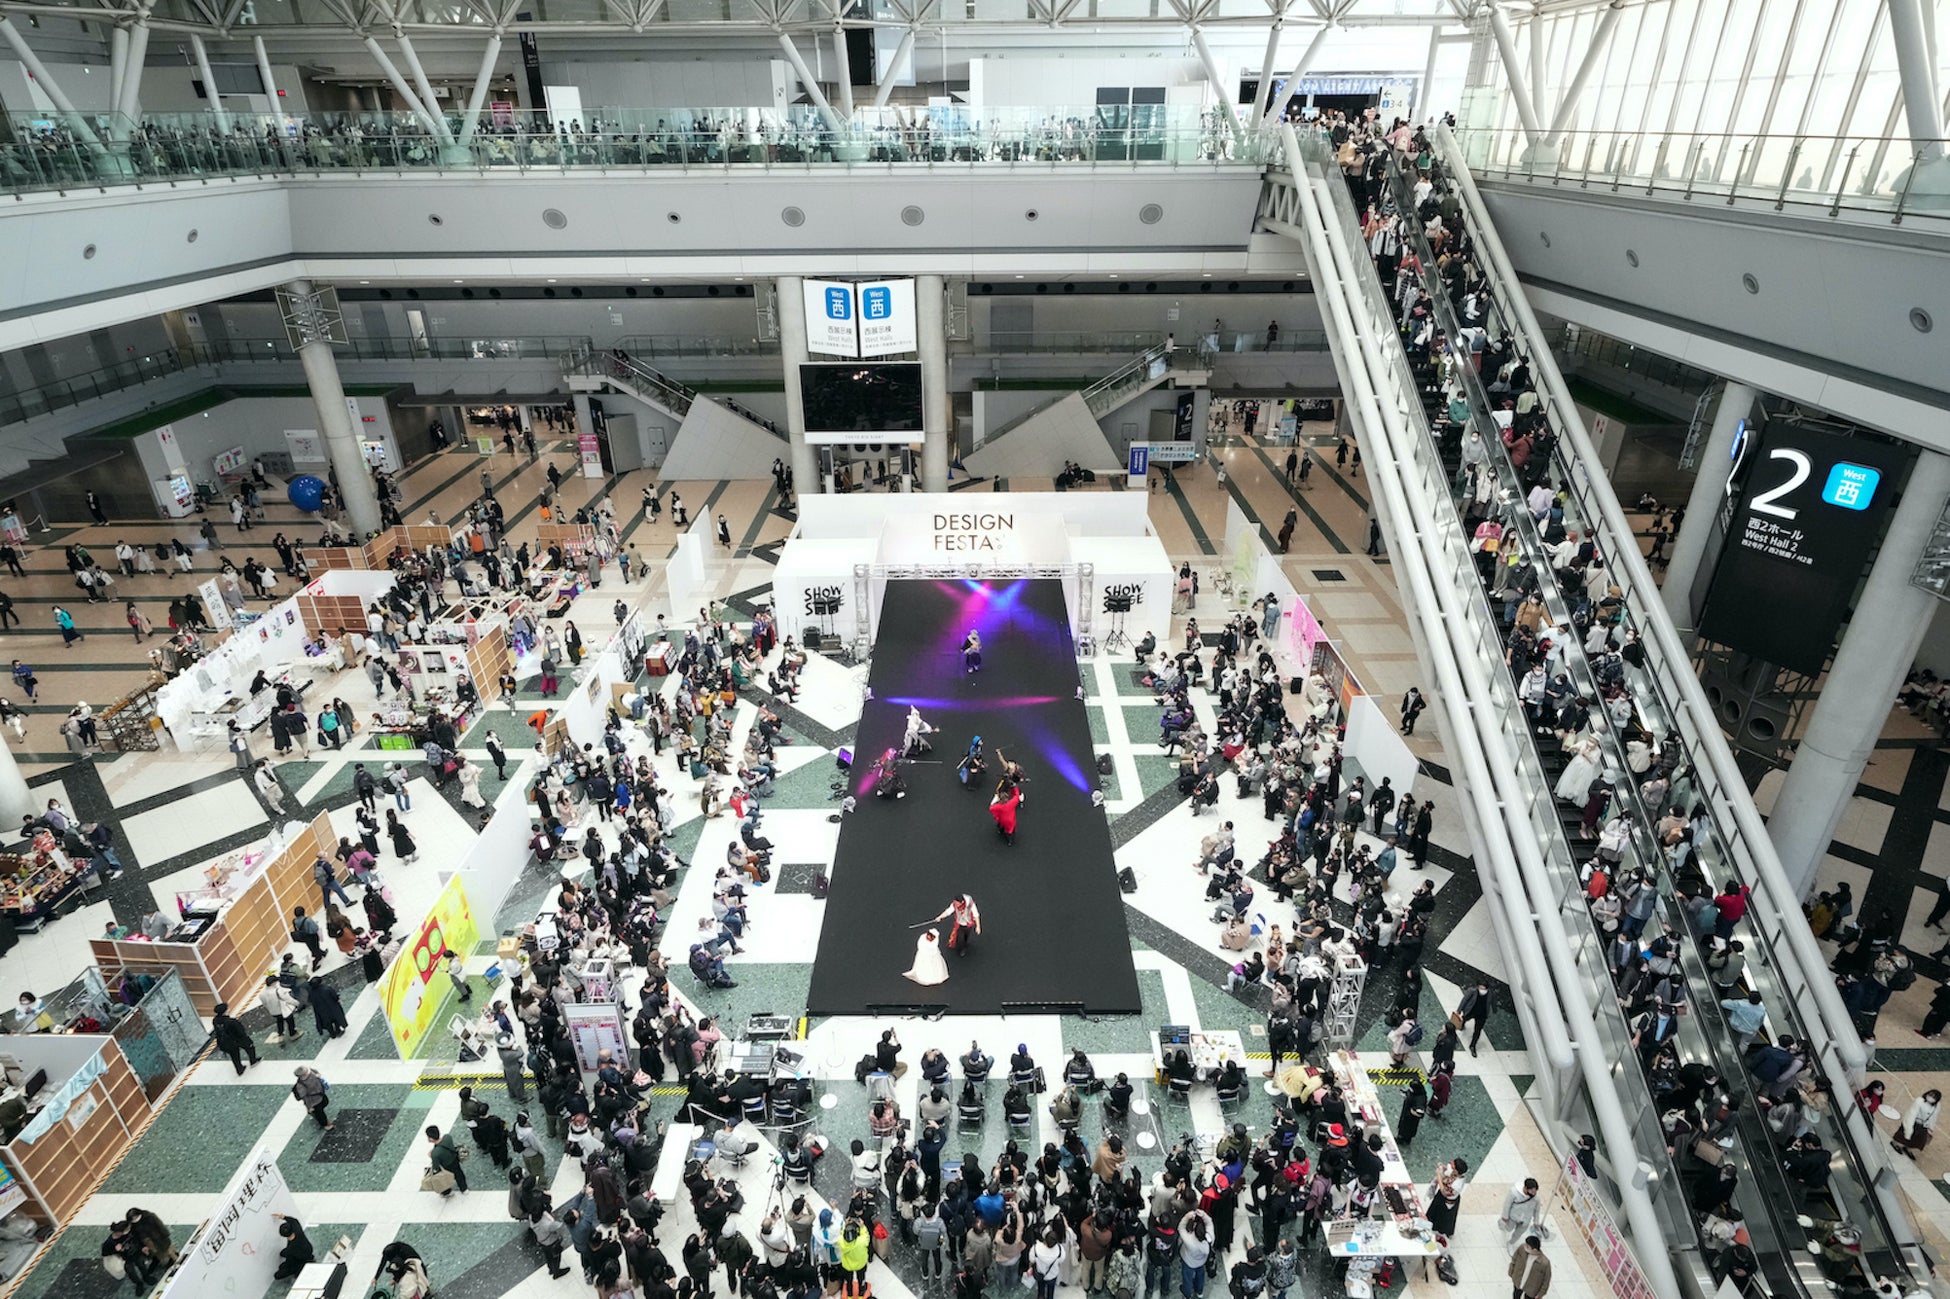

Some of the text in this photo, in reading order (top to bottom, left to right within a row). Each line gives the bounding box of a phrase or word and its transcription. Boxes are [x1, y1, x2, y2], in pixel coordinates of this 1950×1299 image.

[831, 290, 844, 299] West
[869, 290, 884, 298] West
[831, 299, 845, 317] 西
[870, 298, 885, 317] 西
[1184, 403, 1192, 421] 2
[1749, 448, 1811, 520] 2
[1843, 468, 1866, 482] West
[1834, 479, 1862, 505] 西
[933, 514, 1013, 531] DESIGN
[1747, 516, 1804, 540] 西2ホール
[934, 535, 994, 550] FESTA
[1744, 528, 1798, 552] West Hall 2
[804, 583, 845, 602] SHOW
[1103, 582, 1145, 600] SHOW
